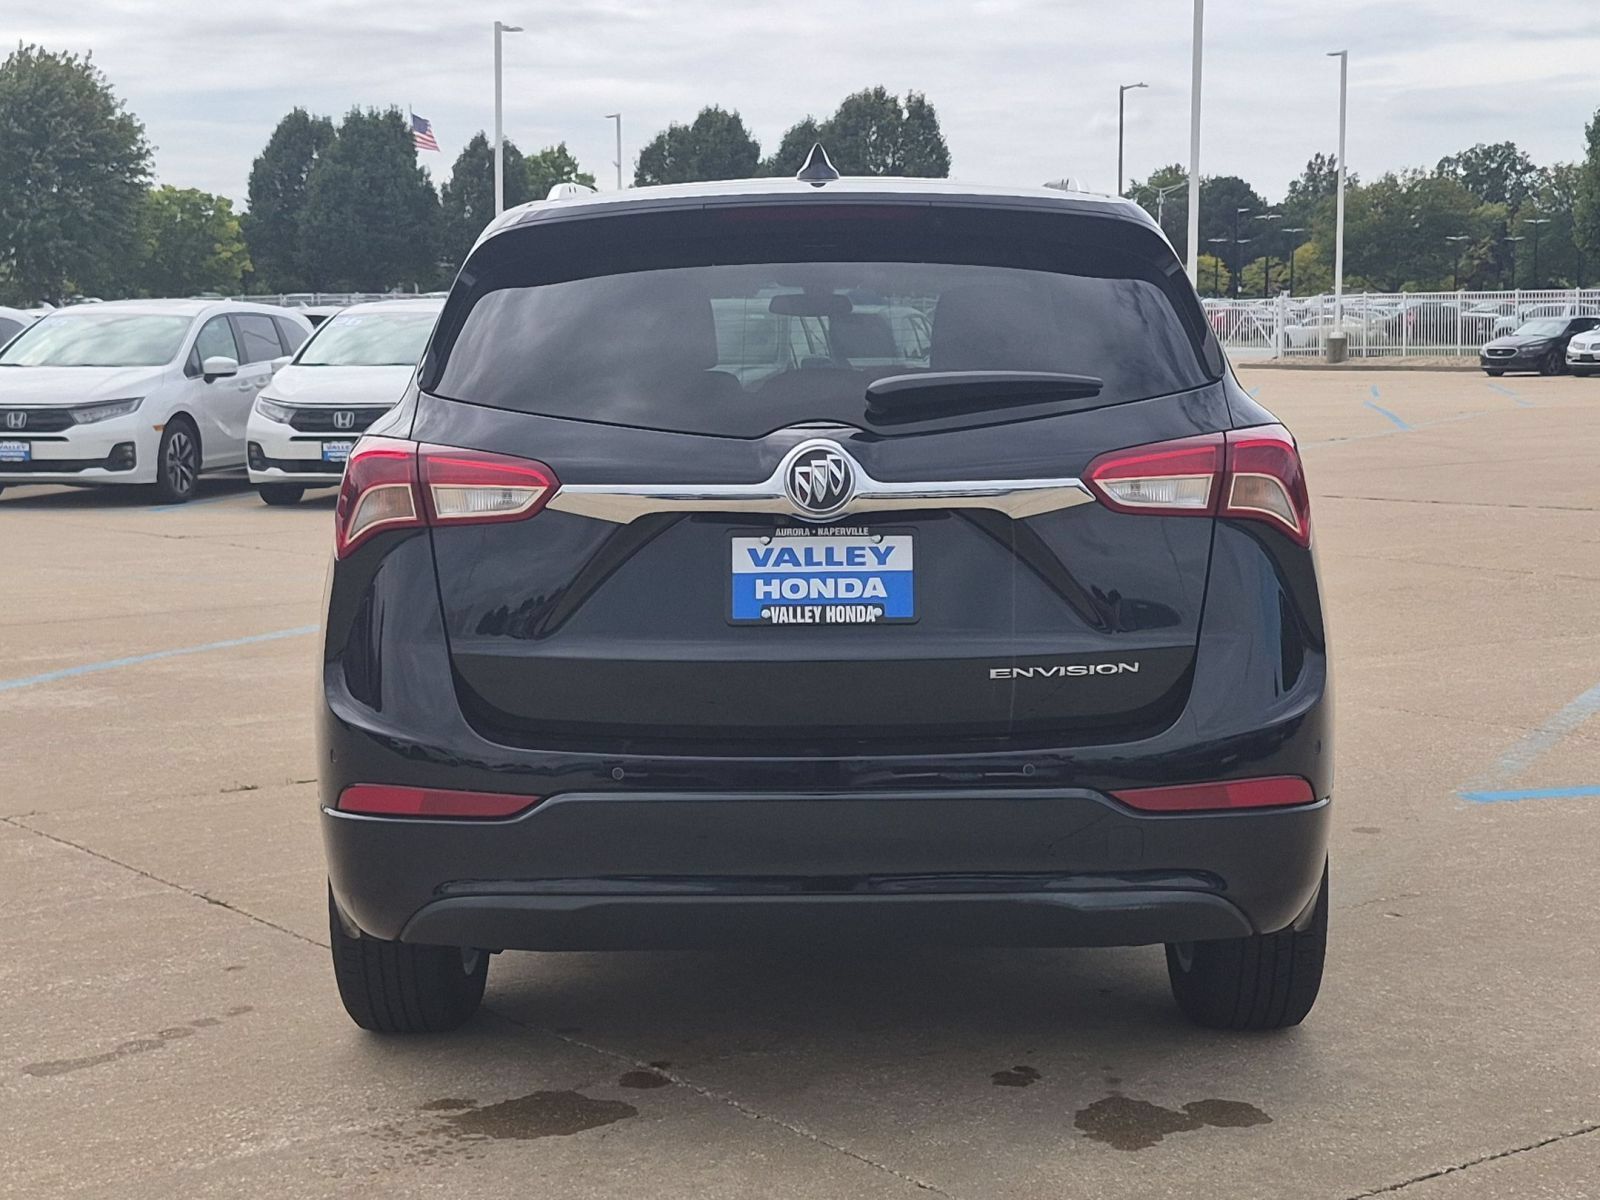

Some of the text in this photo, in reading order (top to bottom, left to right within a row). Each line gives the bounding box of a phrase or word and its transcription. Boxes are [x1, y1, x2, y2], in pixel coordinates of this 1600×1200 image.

[775, 527, 869, 537] AURORA NAPERVILLE
[747, 546, 895, 568] VALLEY
[755, 577, 888, 599] HONDA
[770, 605, 876, 624] VALLEY HONDA
[989, 662, 1140, 679] ENVISION
